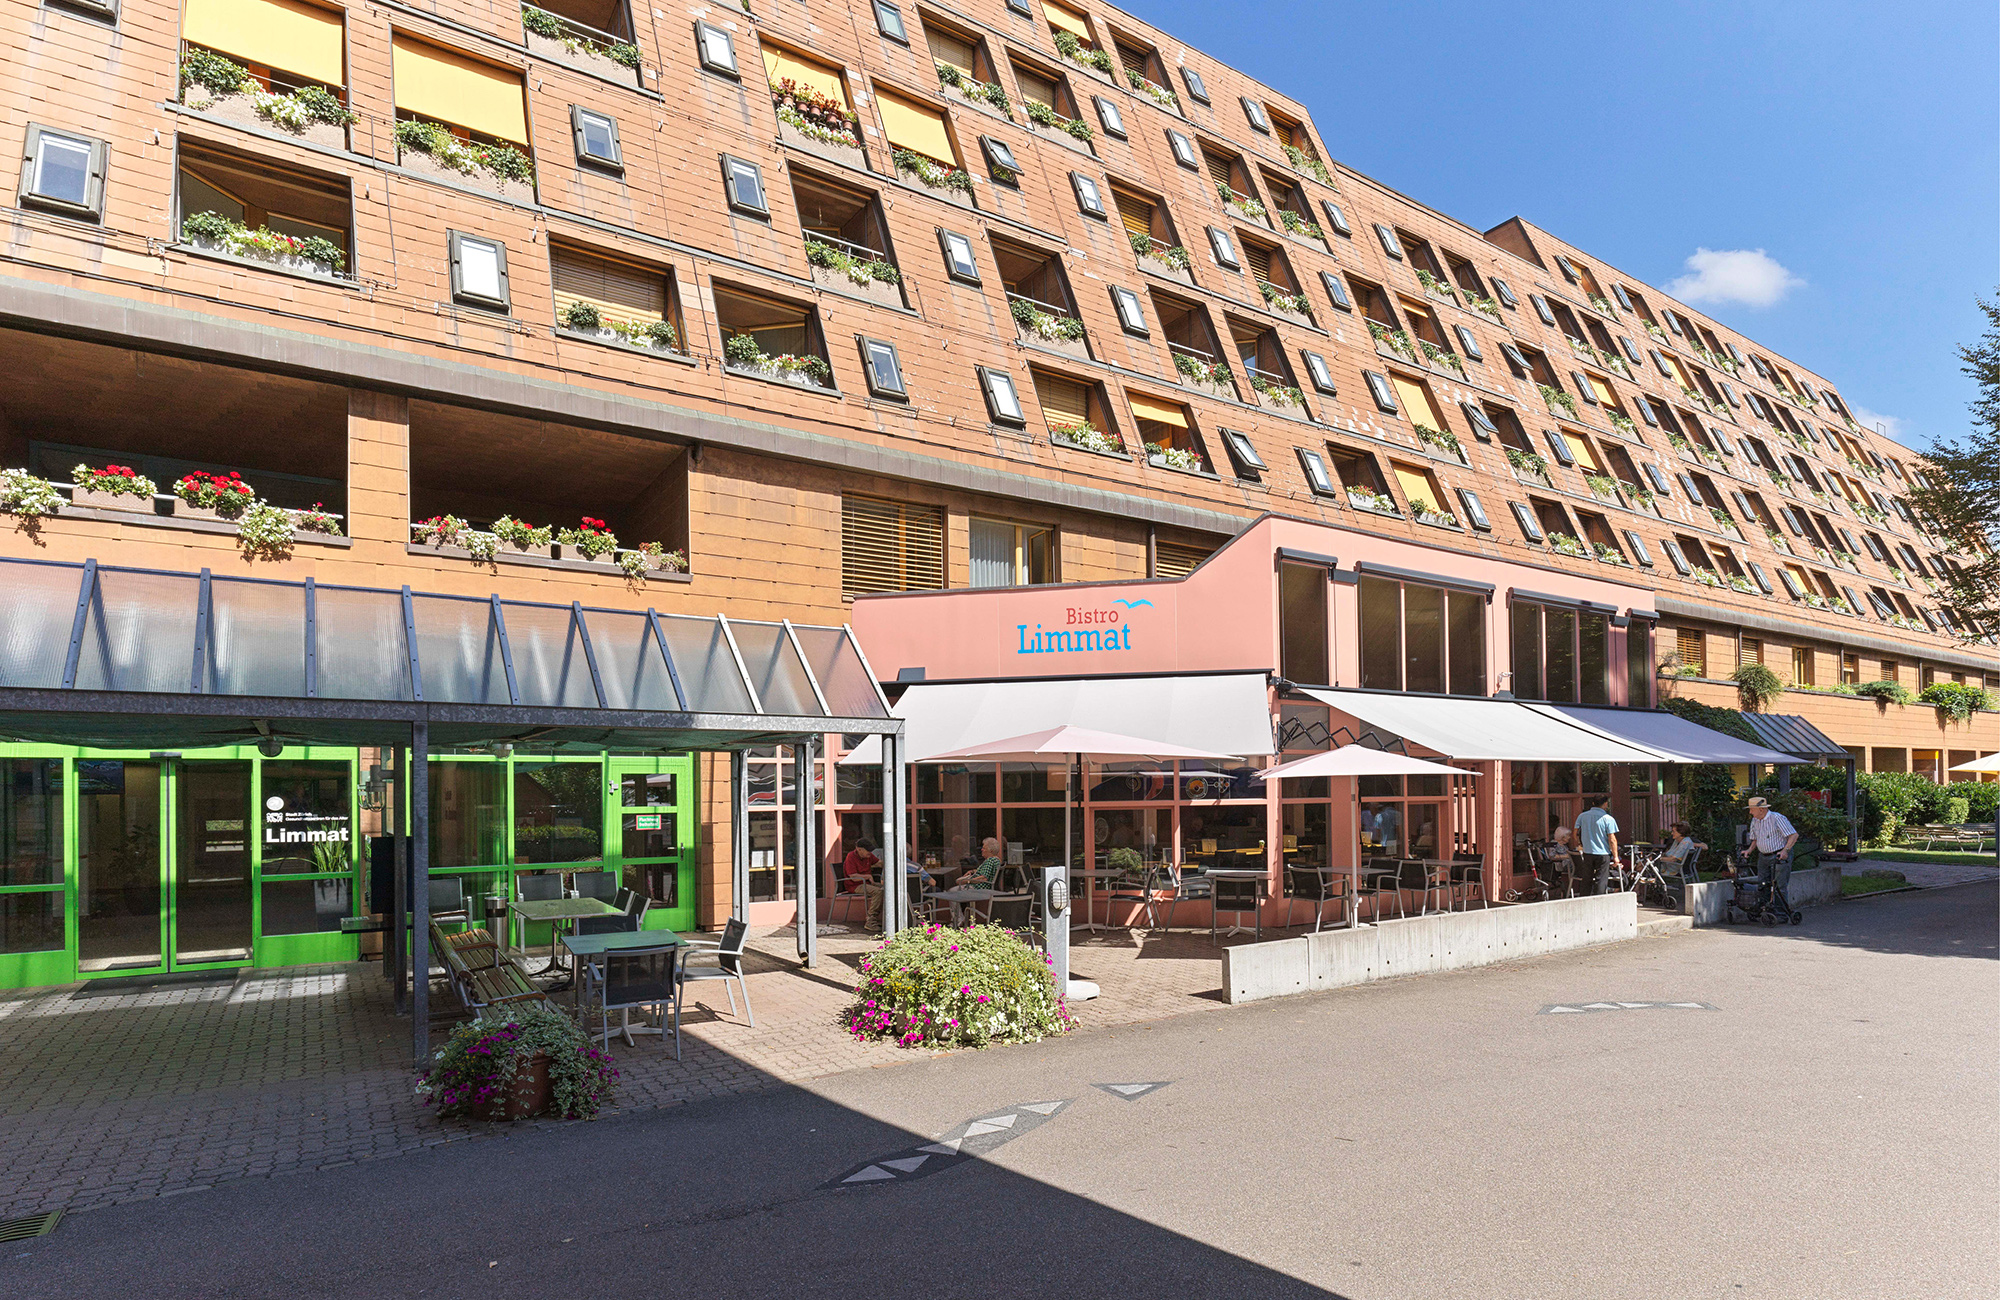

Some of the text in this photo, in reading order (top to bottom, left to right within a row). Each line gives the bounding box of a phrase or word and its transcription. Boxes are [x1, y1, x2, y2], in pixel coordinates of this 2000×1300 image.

[1066, 607, 1119, 625] Bistro
[1017, 623, 1131, 654] Limmat
[266, 828, 349, 842] Limmat
